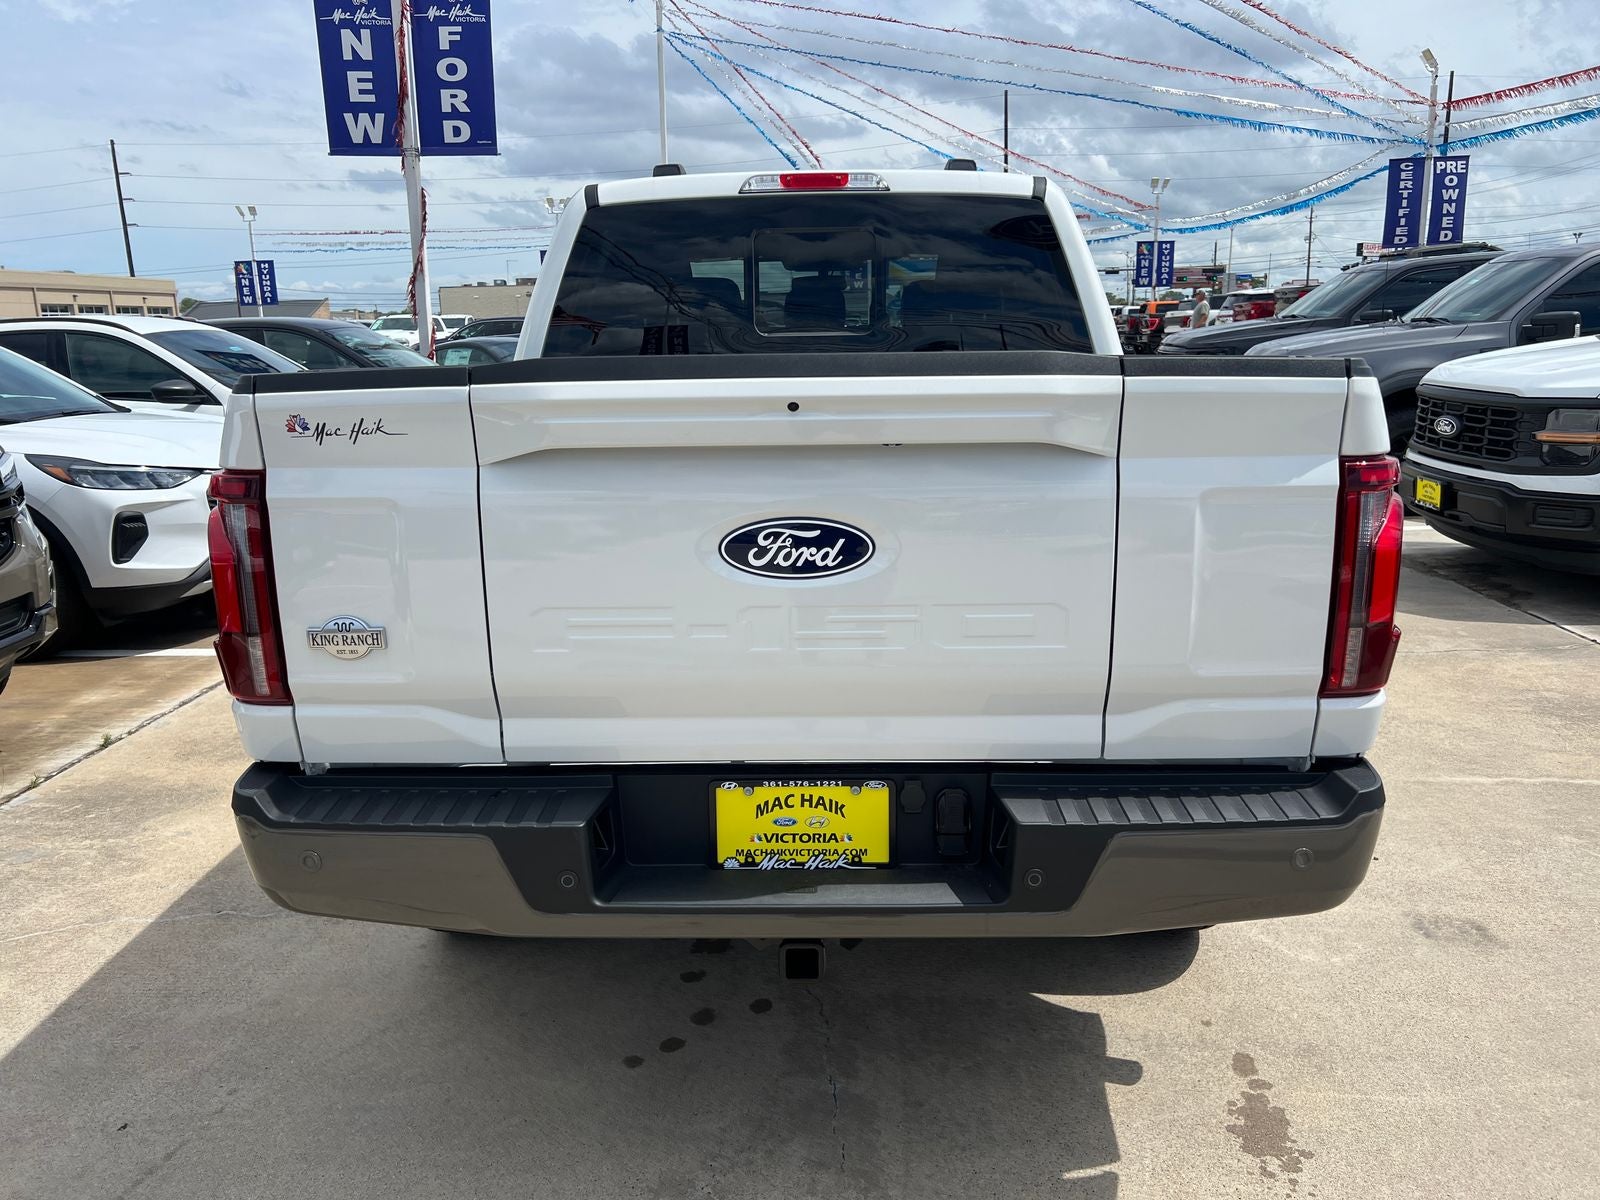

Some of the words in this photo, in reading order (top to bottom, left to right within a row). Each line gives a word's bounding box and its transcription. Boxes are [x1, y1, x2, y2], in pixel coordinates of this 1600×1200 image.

[324, 8, 354, 25] Mac
[354, 6, 387, 25] Haik
[418, 5, 449, 22] Mac
[449, 4, 481, 22] Haik
[340, 28, 385, 144] NEW
[436, 26, 471, 144] FORD
[1436, 161, 1466, 174] PRE
[1393, 162, 1414, 244] CERTIFIED
[1439, 175, 1459, 242] OWNED
[1139, 259, 1149, 285] NEW
[1161, 243, 1170, 285] HYUNDAI
[241, 278, 252, 304] NEW
[261, 263, 272, 303] HYUNDAI
[305, 422, 347, 446] Mac
[349, 417, 400, 445] Haik
[747, 527, 846, 567] Ford
[311, 633, 339, 646] KING
[341, 632, 380, 646] RANCH
[530, 602, 1071, 653] F-150
[755, 793, 795, 819] MAC
[800, 793, 846, 819] HAIK
[763, 832, 839, 844] VICTORIA
[735, 848, 868, 858] MACHAIKVICTORIA.COM
[753, 853, 802, 871] Mac
[804, 853, 860, 871] Haik
